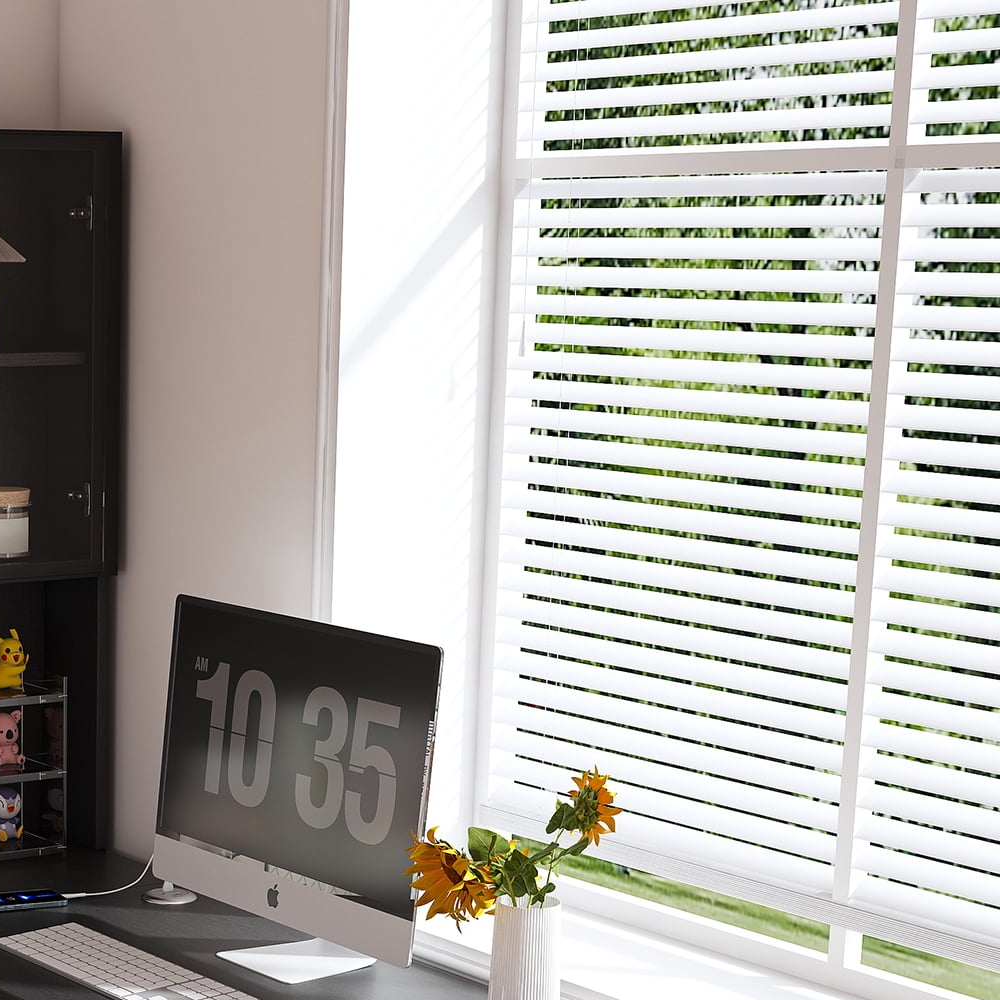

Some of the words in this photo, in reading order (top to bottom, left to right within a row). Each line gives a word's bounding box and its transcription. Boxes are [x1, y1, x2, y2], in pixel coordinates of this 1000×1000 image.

[195, 656, 209, 673] AM
[196, 661, 277, 808] 10
[294, 686, 401, 846] 35
